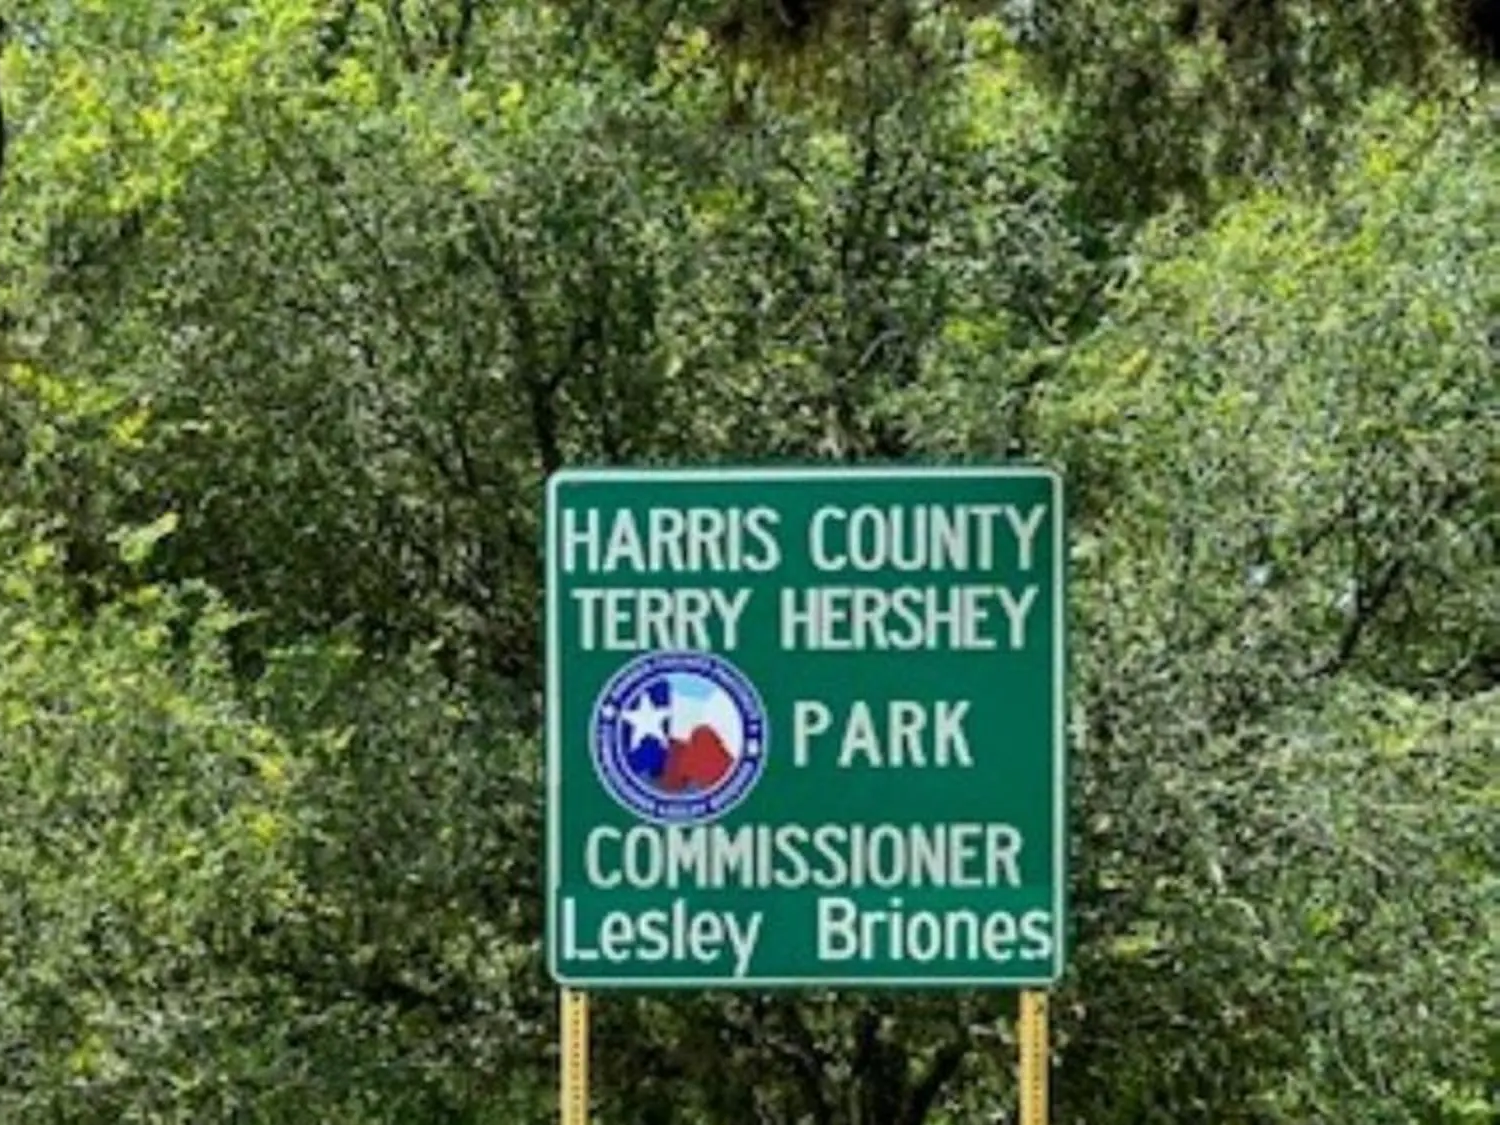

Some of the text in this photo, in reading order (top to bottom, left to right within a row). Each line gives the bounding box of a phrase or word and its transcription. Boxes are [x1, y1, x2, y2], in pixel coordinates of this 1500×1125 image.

[562, 505, 1046, 573] HARRIS COUNTY
[571, 586, 1039, 652] TERRY HERSHEY
[793, 700, 973, 768] PARK
[585, 823, 1022, 889] COMMISSIONER
[562, 897, 1053, 977] Lesley Briones
